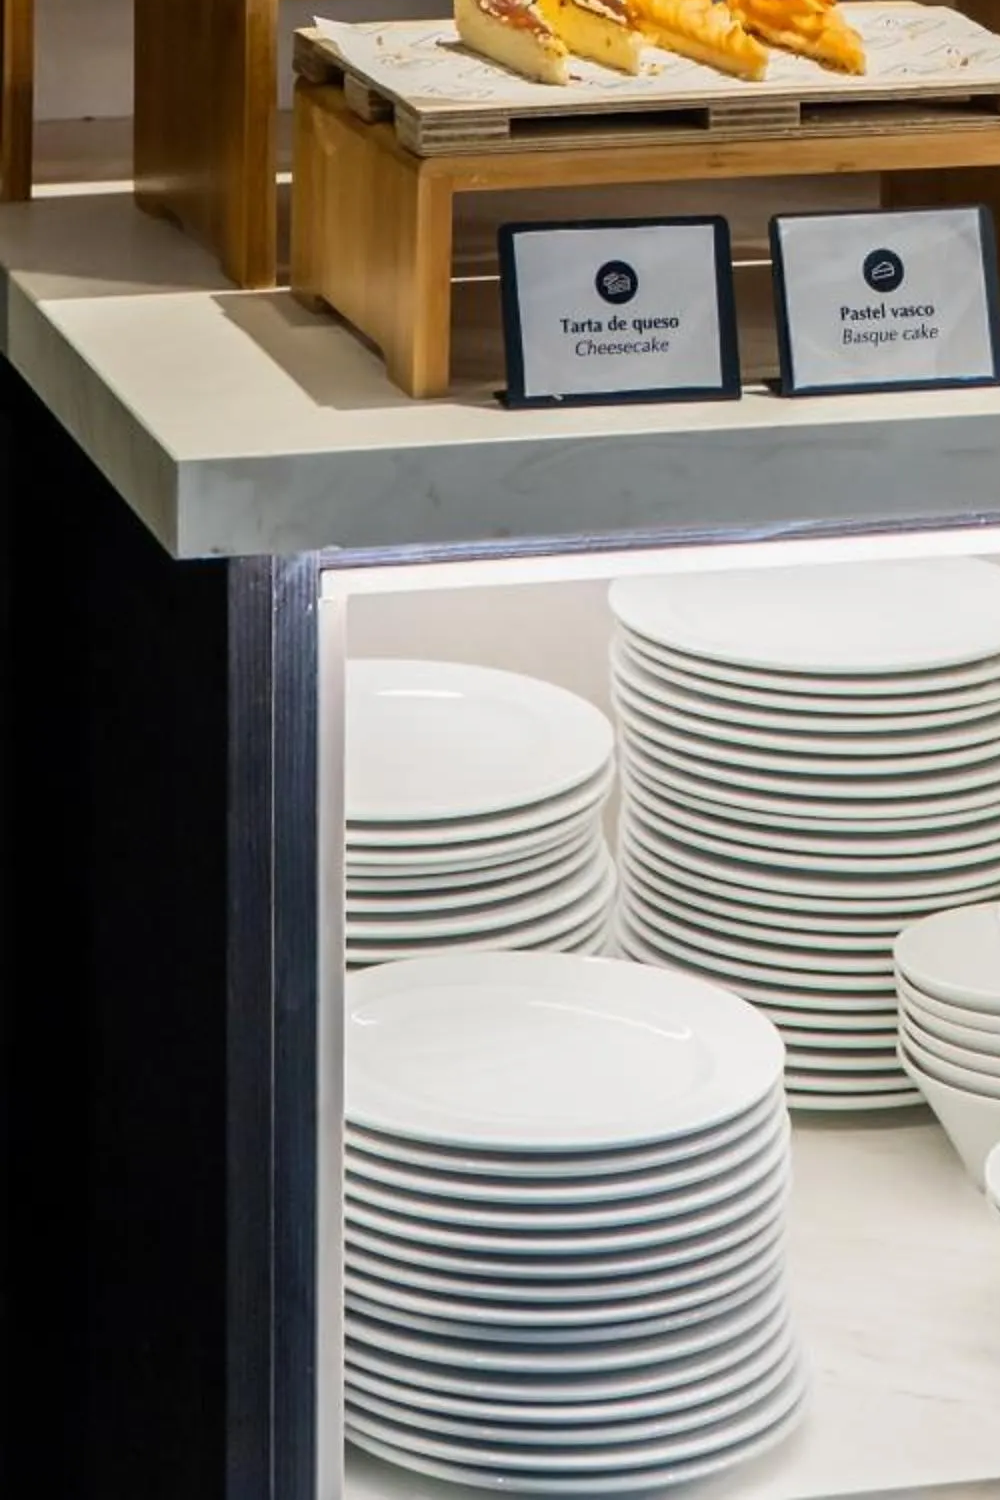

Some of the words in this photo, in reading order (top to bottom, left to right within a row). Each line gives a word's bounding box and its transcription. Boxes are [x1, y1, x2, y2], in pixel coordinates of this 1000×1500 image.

[840, 302, 886, 321] Pastel
[890, 304, 935, 318] vasco
[560, 317, 602, 334] Tarta
[607, 315, 628, 331] de
[631, 317, 680, 335] queso
[842, 327, 898, 347] Basque
[901, 323, 940, 341] cake
[575, 337, 669, 357] Cheesecake
